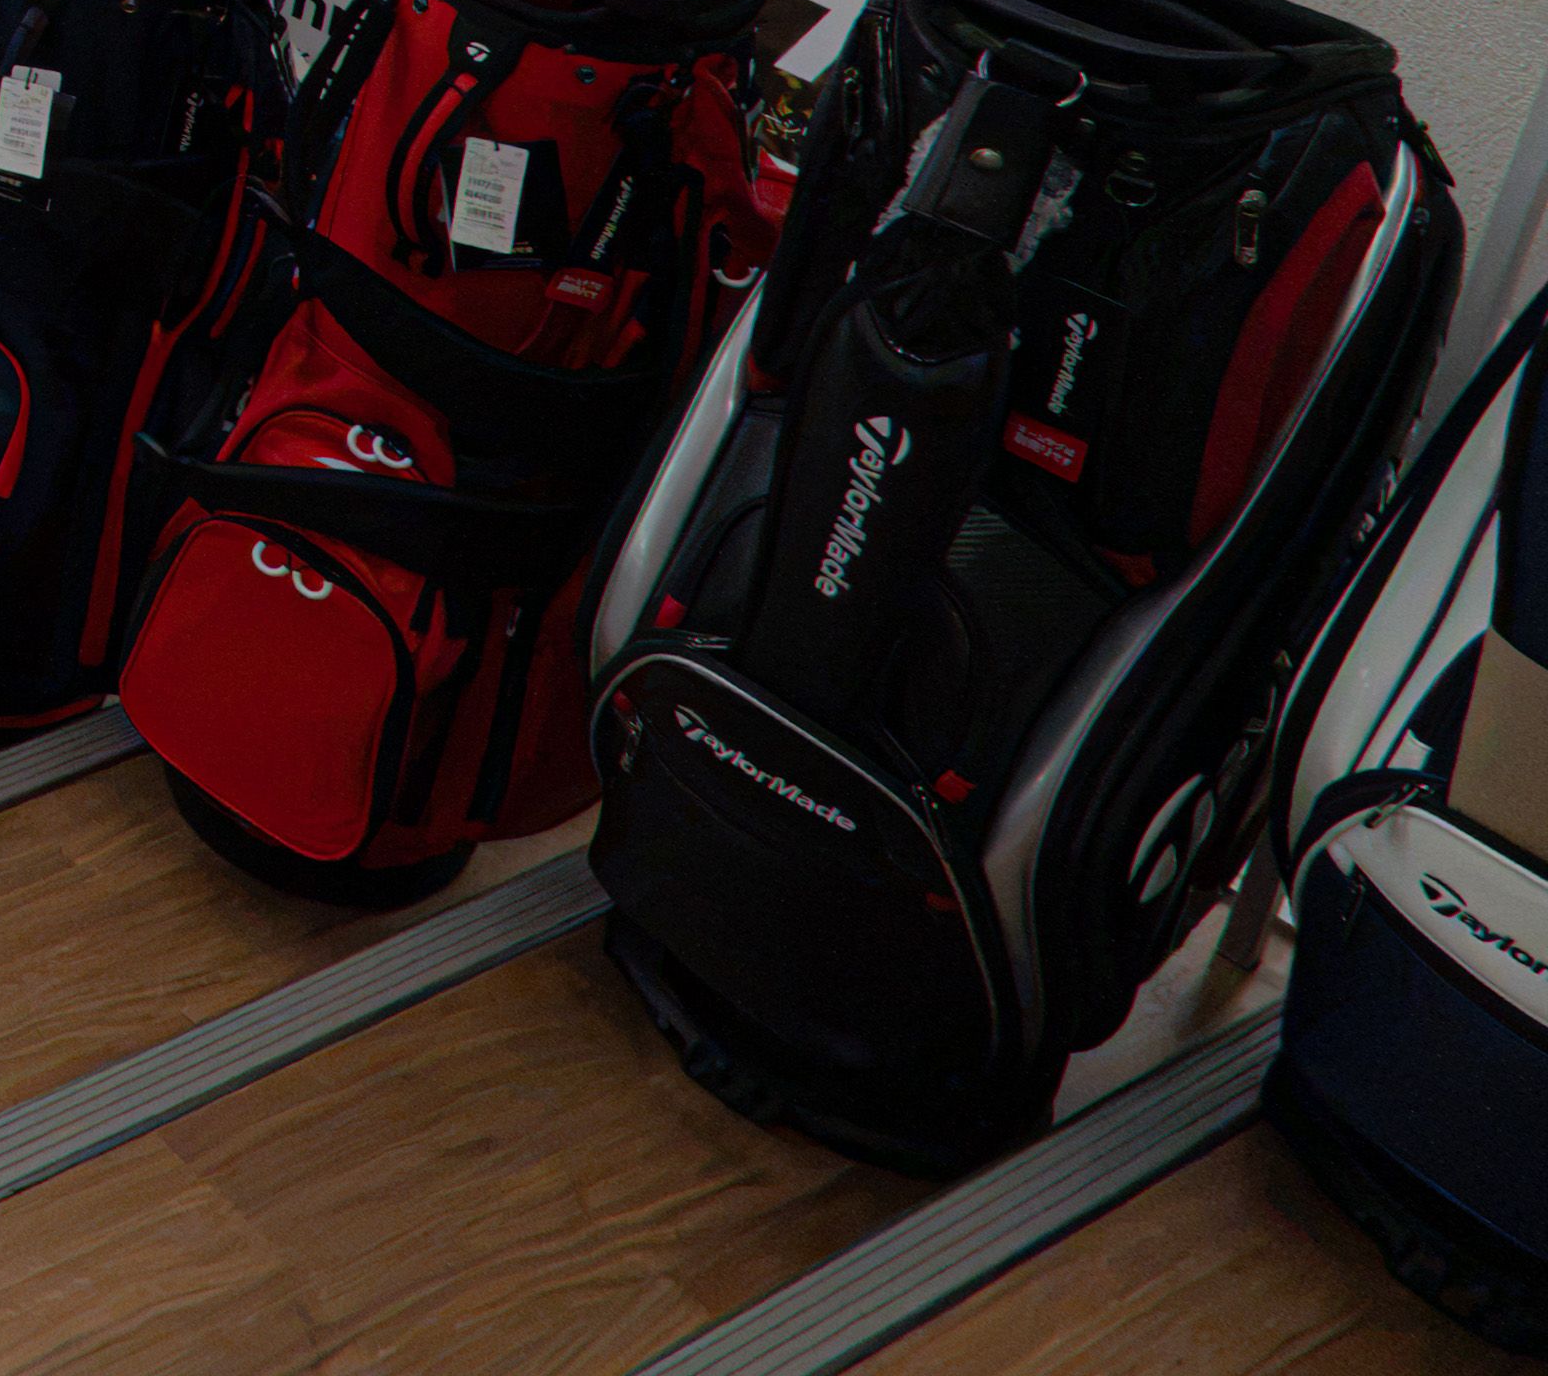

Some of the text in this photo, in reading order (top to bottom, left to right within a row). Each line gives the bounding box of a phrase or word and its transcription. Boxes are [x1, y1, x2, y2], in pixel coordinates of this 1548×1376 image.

[1046, 310, 1099, 414] TaylorMade
[815, 413, 914, 600] TaylorMade
[674, 704, 858, 832] TaylorMade
[1419, 872, 1548, 976] Taylor
